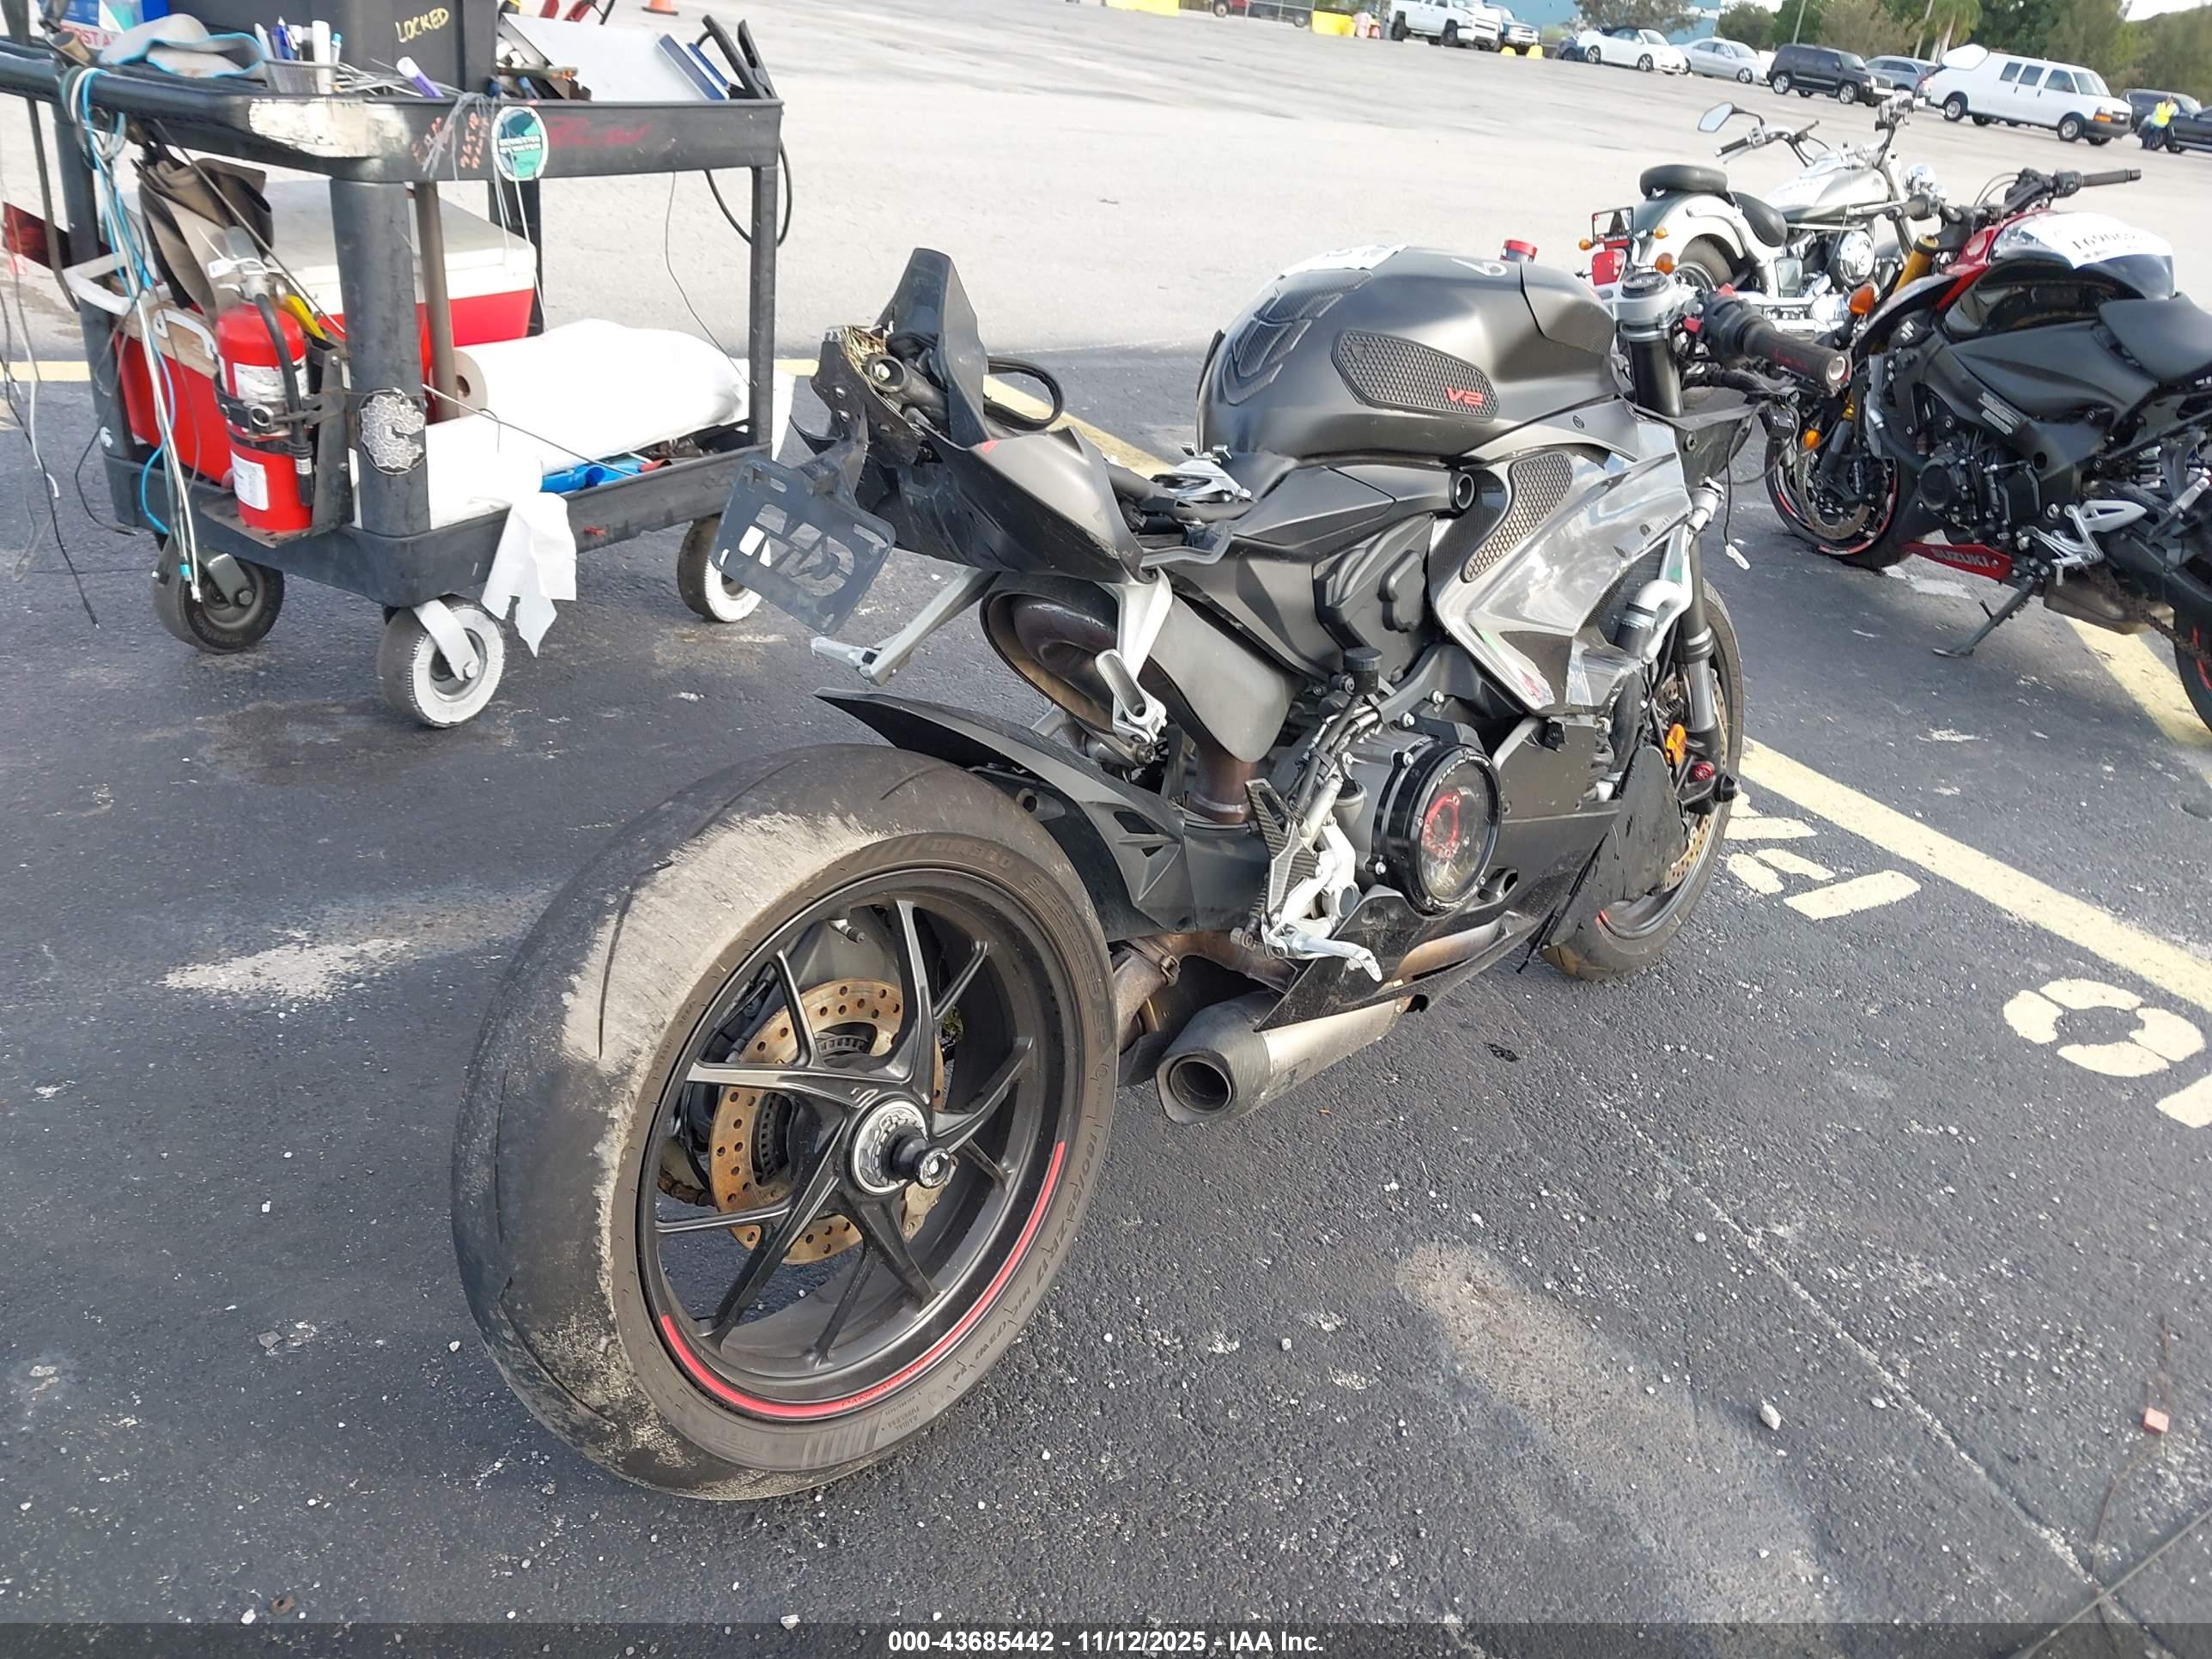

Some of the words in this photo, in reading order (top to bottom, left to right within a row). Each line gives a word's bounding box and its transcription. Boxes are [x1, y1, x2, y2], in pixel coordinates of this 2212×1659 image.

[395, 7, 449, 43] LOCKED
[1446, 386, 1484, 406] V2
[1929, 548, 1990, 568] SUZUKI
